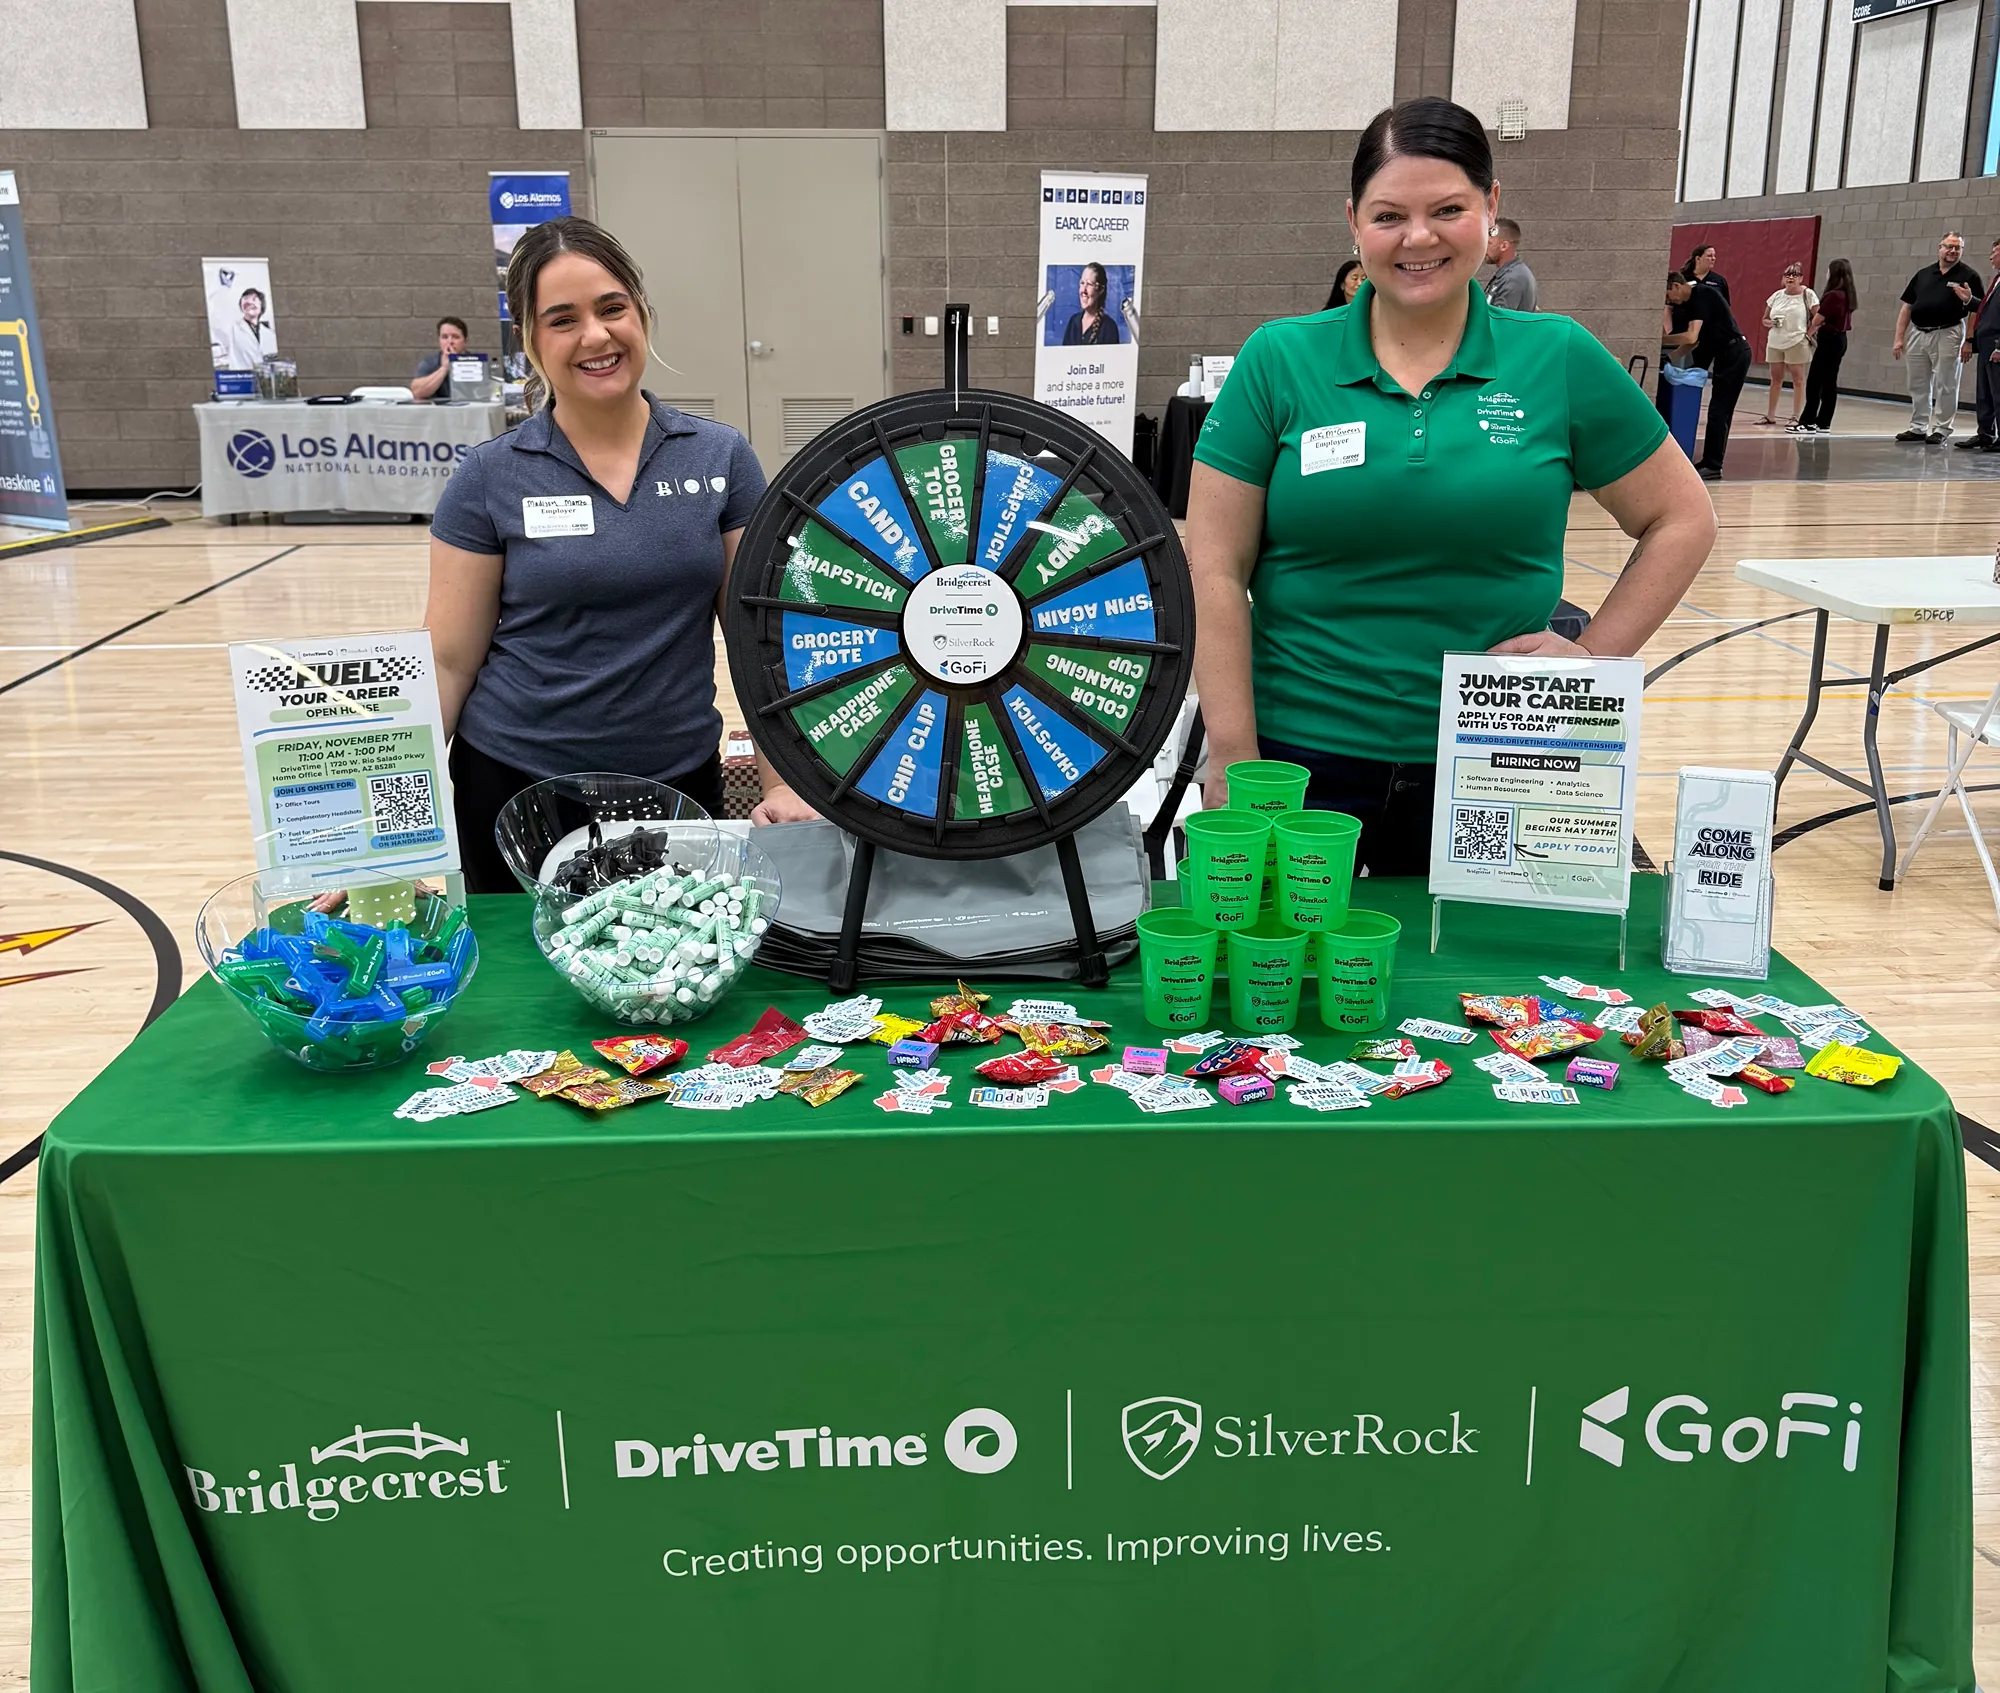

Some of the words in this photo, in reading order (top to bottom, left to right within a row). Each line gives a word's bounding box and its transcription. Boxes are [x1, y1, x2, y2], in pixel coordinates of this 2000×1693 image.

[1854, 4, 1872, 18] SCORE
[514, 194, 528, 202] Los
[530, 193, 562, 202] Alamos
[1055, 216, 1088, 230] EARLY
[1089, 218, 1130, 231] CAREER
[1072, 234, 1112, 243] PROGRAMS
[1067, 365, 1087, 376] Join
[1089, 364, 1104, 374] Ball
[1046, 382, 1064, 392] and
[1066, 380, 1093, 395] shape
[1095, 382, 1100, 390] a
[1102, 381, 1124, 390] more
[1096, 394, 1126, 405] future!
[281, 434, 337, 458] Los
[344, 433, 467, 463] Alamos
[1316, 438, 1350, 448] Employer
[286, 462, 360, 474] NATIONAL
[655, 482, 673, 496] B
[924, 466, 944, 521] TOTE
[940, 444, 968, 537] GROCERY
[847, 480, 918, 558] CANDY
[985, 465, 1034, 563] CHAPSTICK
[936, 576, 992, 590] Bridgecrest
[930, 605, 984, 616] DriveTime
[1105, 593, 1149, 616] SPIN
[1038, 603, 1098, 628] AGAIN
[792, 629, 878, 650] GROCERY
[948, 637, 996, 648] SilverRock
[812, 649, 862, 665] TOTE
[950, 660, 988, 675] GoFi
[1108, 657, 1144, 678] CUP
[296, 661, 380, 689] FUEL
[1046, 653, 1137, 698] CHANGING
[1459, 673, 1596, 694] JUMPSTART
[279, 692, 328, 707] YOUR
[1069, 686, 1128, 720] COLOR
[1459, 690, 1522, 708] YOUR
[1527, 694, 1625, 712] CAREER!
[306, 707, 338, 718] OPEN
[340, 704, 380, 714] HOSE
[809, 672, 896, 743] HEADPHONE
[838, 702, 882, 740] CASE
[1458, 710, 1496, 721] APPLY
[1500, 712, 1523, 722] FOR
[1526, 714, 1544, 722] AN
[1547, 715, 1620, 727] INTERNSHIP
[1458, 720, 1490, 730] WITH
[1492, 721, 1508, 730] US
[1511, 722, 1556, 732] TODAY!
[277, 741, 322, 753] FRIDAY,
[325, 733, 388, 748] NOVEMBER
[392, 732, 412, 741] 7TH
[1008, 697, 1080, 781] CHAPSTICK
[1459, 736, 1624, 750] WWW.JOBS.DRIVETIME.COM/INTERNSHIPS
[298, 752, 324, 762] 11:00
[326, 750, 345, 760] AM
[355, 746, 376, 756] 1:00
[378, 744, 396, 753] PM
[888, 750, 917, 803] CHIP
[908, 703, 936, 750] CLIP
[280, 763, 322, 773] DriveTime
[330, 760, 348, 768] 1720
[376, 755, 402, 764] Salado
[404, 752, 426, 761] Pkwy
[966, 718, 994, 814] HEADPHONE
[985, 744, 1004, 788] CASE
[1496, 756, 1540, 768] HIRING
[1544, 759, 1578, 770] NOW
[272, 774, 296, 782] Home
[298, 771, 322, 780] Office
[331, 767, 360, 776] Tempe,
[374, 763, 396, 771] 85281
[1466, 775, 1498, 783] Software
[1500, 777, 1544, 786] Engineering
[1556, 780, 1590, 788] Analytics
[277, 788, 294, 796] JOIN
[308, 783, 336, 792] ONSITE
[1466, 784, 1492, 792] Human
[1494, 786, 1530, 794] Resources
[1574, 790, 1604, 798] Science
[1250, 802, 1288, 811] Bridgecrest
[286, 812, 330, 822] Complimentary
[332, 809, 362, 818] Headshots
[1549, 817, 1571, 826] OUR
[1574, 818, 1617, 828] SUMMER
[380, 833, 417, 842] REGISTER
[418, 830, 436, 838] NOW
[1525, 824, 1562, 833] BEGINS
[1564, 826, 1587, 835] MAY
[1590, 828, 1618, 837] 18TH!
[1698, 828, 1752, 846] COME
[393, 836, 438, 847] HANDSHAKE!
[1534, 841, 1570, 851] APPLY
[1574, 844, 1616, 854] TODAY!
[332, 846, 358, 855] provided
[1688, 842, 1755, 861] ALONG
[1211, 856, 1250, 865] Bridgecrest
[1289, 855, 1327, 865] Bridgecrest
[1696, 860, 1722, 870] FOR
[1722, 862, 1747, 872] THE
[1208, 874, 1244, 882] DriveTime
[1287, 874, 1320, 884] DriveTime
[1698, 870, 1744, 888] RIDE
[1220, 894, 1249, 902] SilverRock
[1298, 896, 1328, 904] SilverRock
[1222, 912, 1244, 922] GoFi
[1300, 914, 1322, 923] GoFi
[1334, 958, 1373, 968] Bridgecrest
[1332, 976, 1368, 986] DriveTime
[1344, 996, 1374, 1006] SilverRock
[832, 1019, 868, 1028] RIGHT
[1346, 1015, 1369, 1024] GoFi
[1404, 1022, 1474, 1042] CARPOOL
[1673, 1042, 1742, 1076] CARPOOL
[716, 1068, 766, 1082] RIGHT
[1292, 1062, 1335, 1080] DIFFERENCE
[673, 1089, 742, 1103] CARPOOL
[973, 1090, 1044, 1102] CARPOOL
[1297, 1088, 1334, 1096] THING
[1500, 1087, 1575, 1100] CARPOOL
[1311, 1098, 1360, 1106] RIGHT
[185, 1458, 506, 1522] Bridgecrest
[614, 1425, 922, 1478] DriveTime
[1213, 1410, 1478, 1459] SilverRock
[1643, 1391, 1864, 1473] GoFi
[662, 1538, 824, 1578] Creating
[836, 1530, 1094, 1572] opportunities.
[1105, 1528, 1290, 1565] Improving
[1302, 1524, 1392, 1554] lives.
